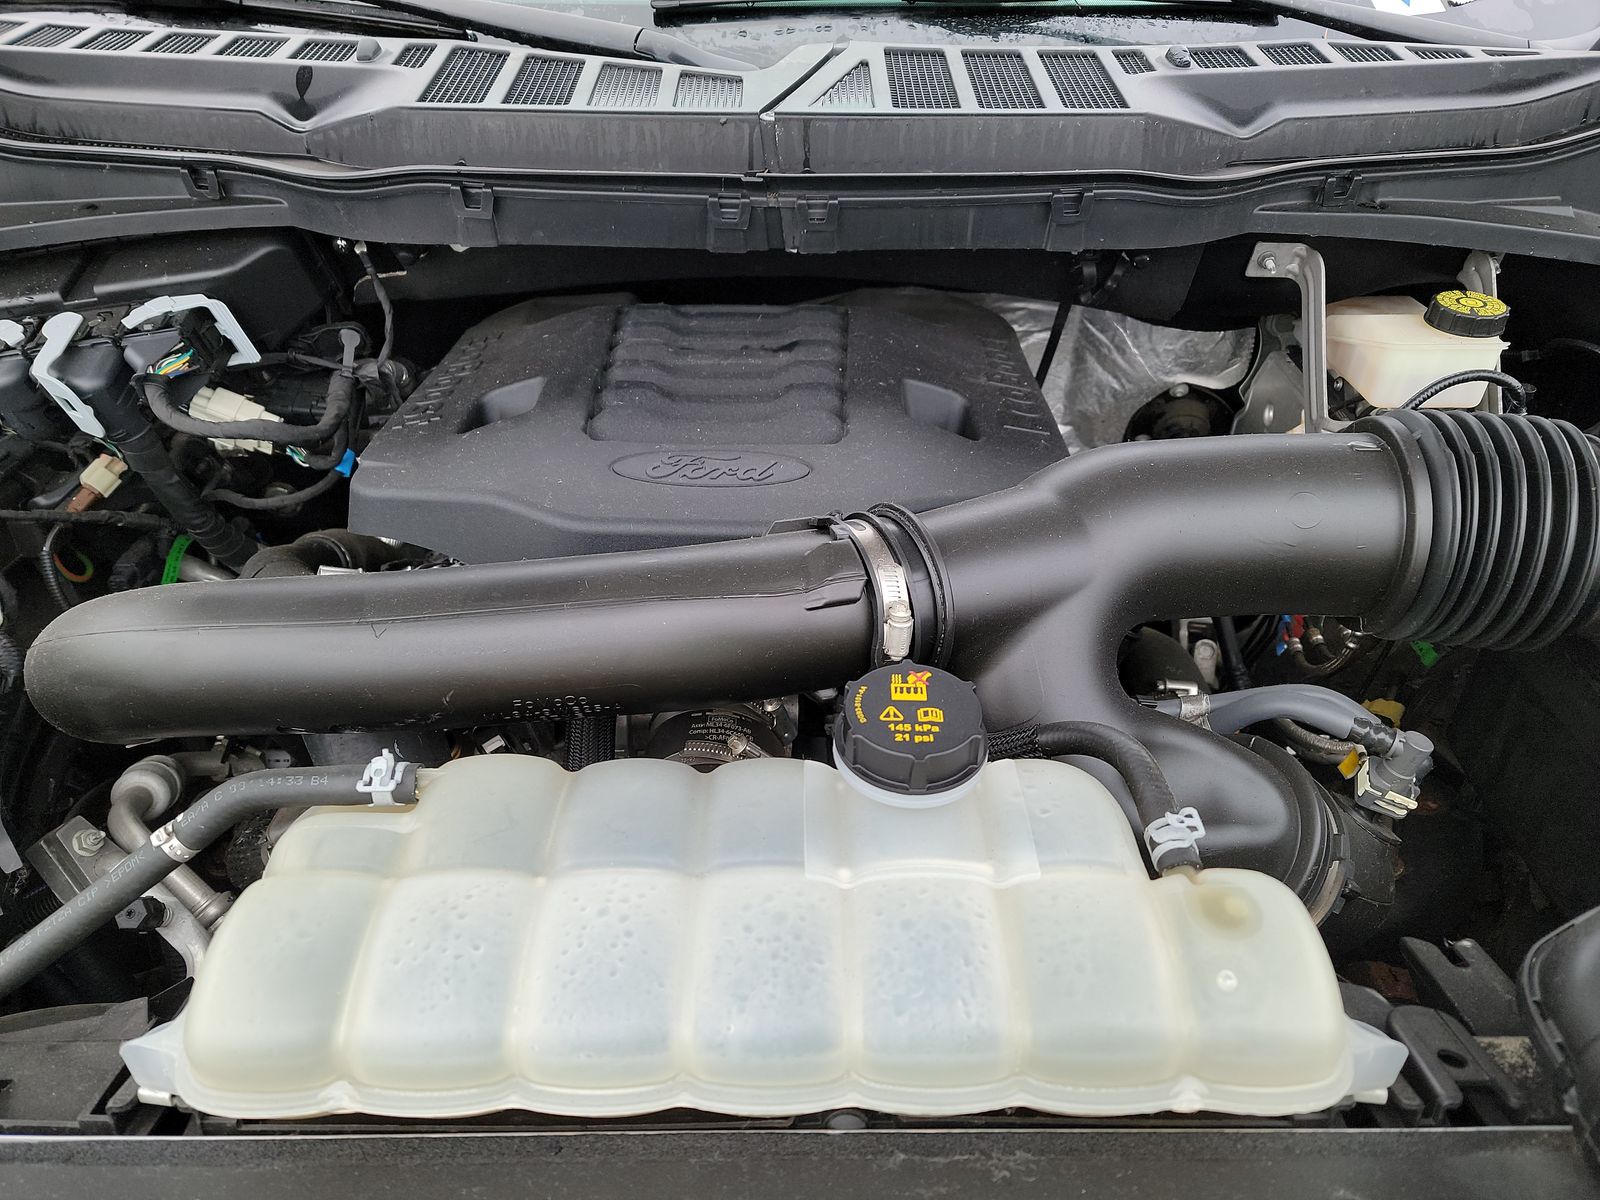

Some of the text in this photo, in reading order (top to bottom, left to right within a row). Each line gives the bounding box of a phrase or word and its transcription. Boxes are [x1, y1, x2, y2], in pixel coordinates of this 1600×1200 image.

[645, 454, 778, 482] Ford
[887, 723, 940, 733] 145 kPa
[894, 733, 935, 744] 21 psi
[310, 775, 329, 786] B4
